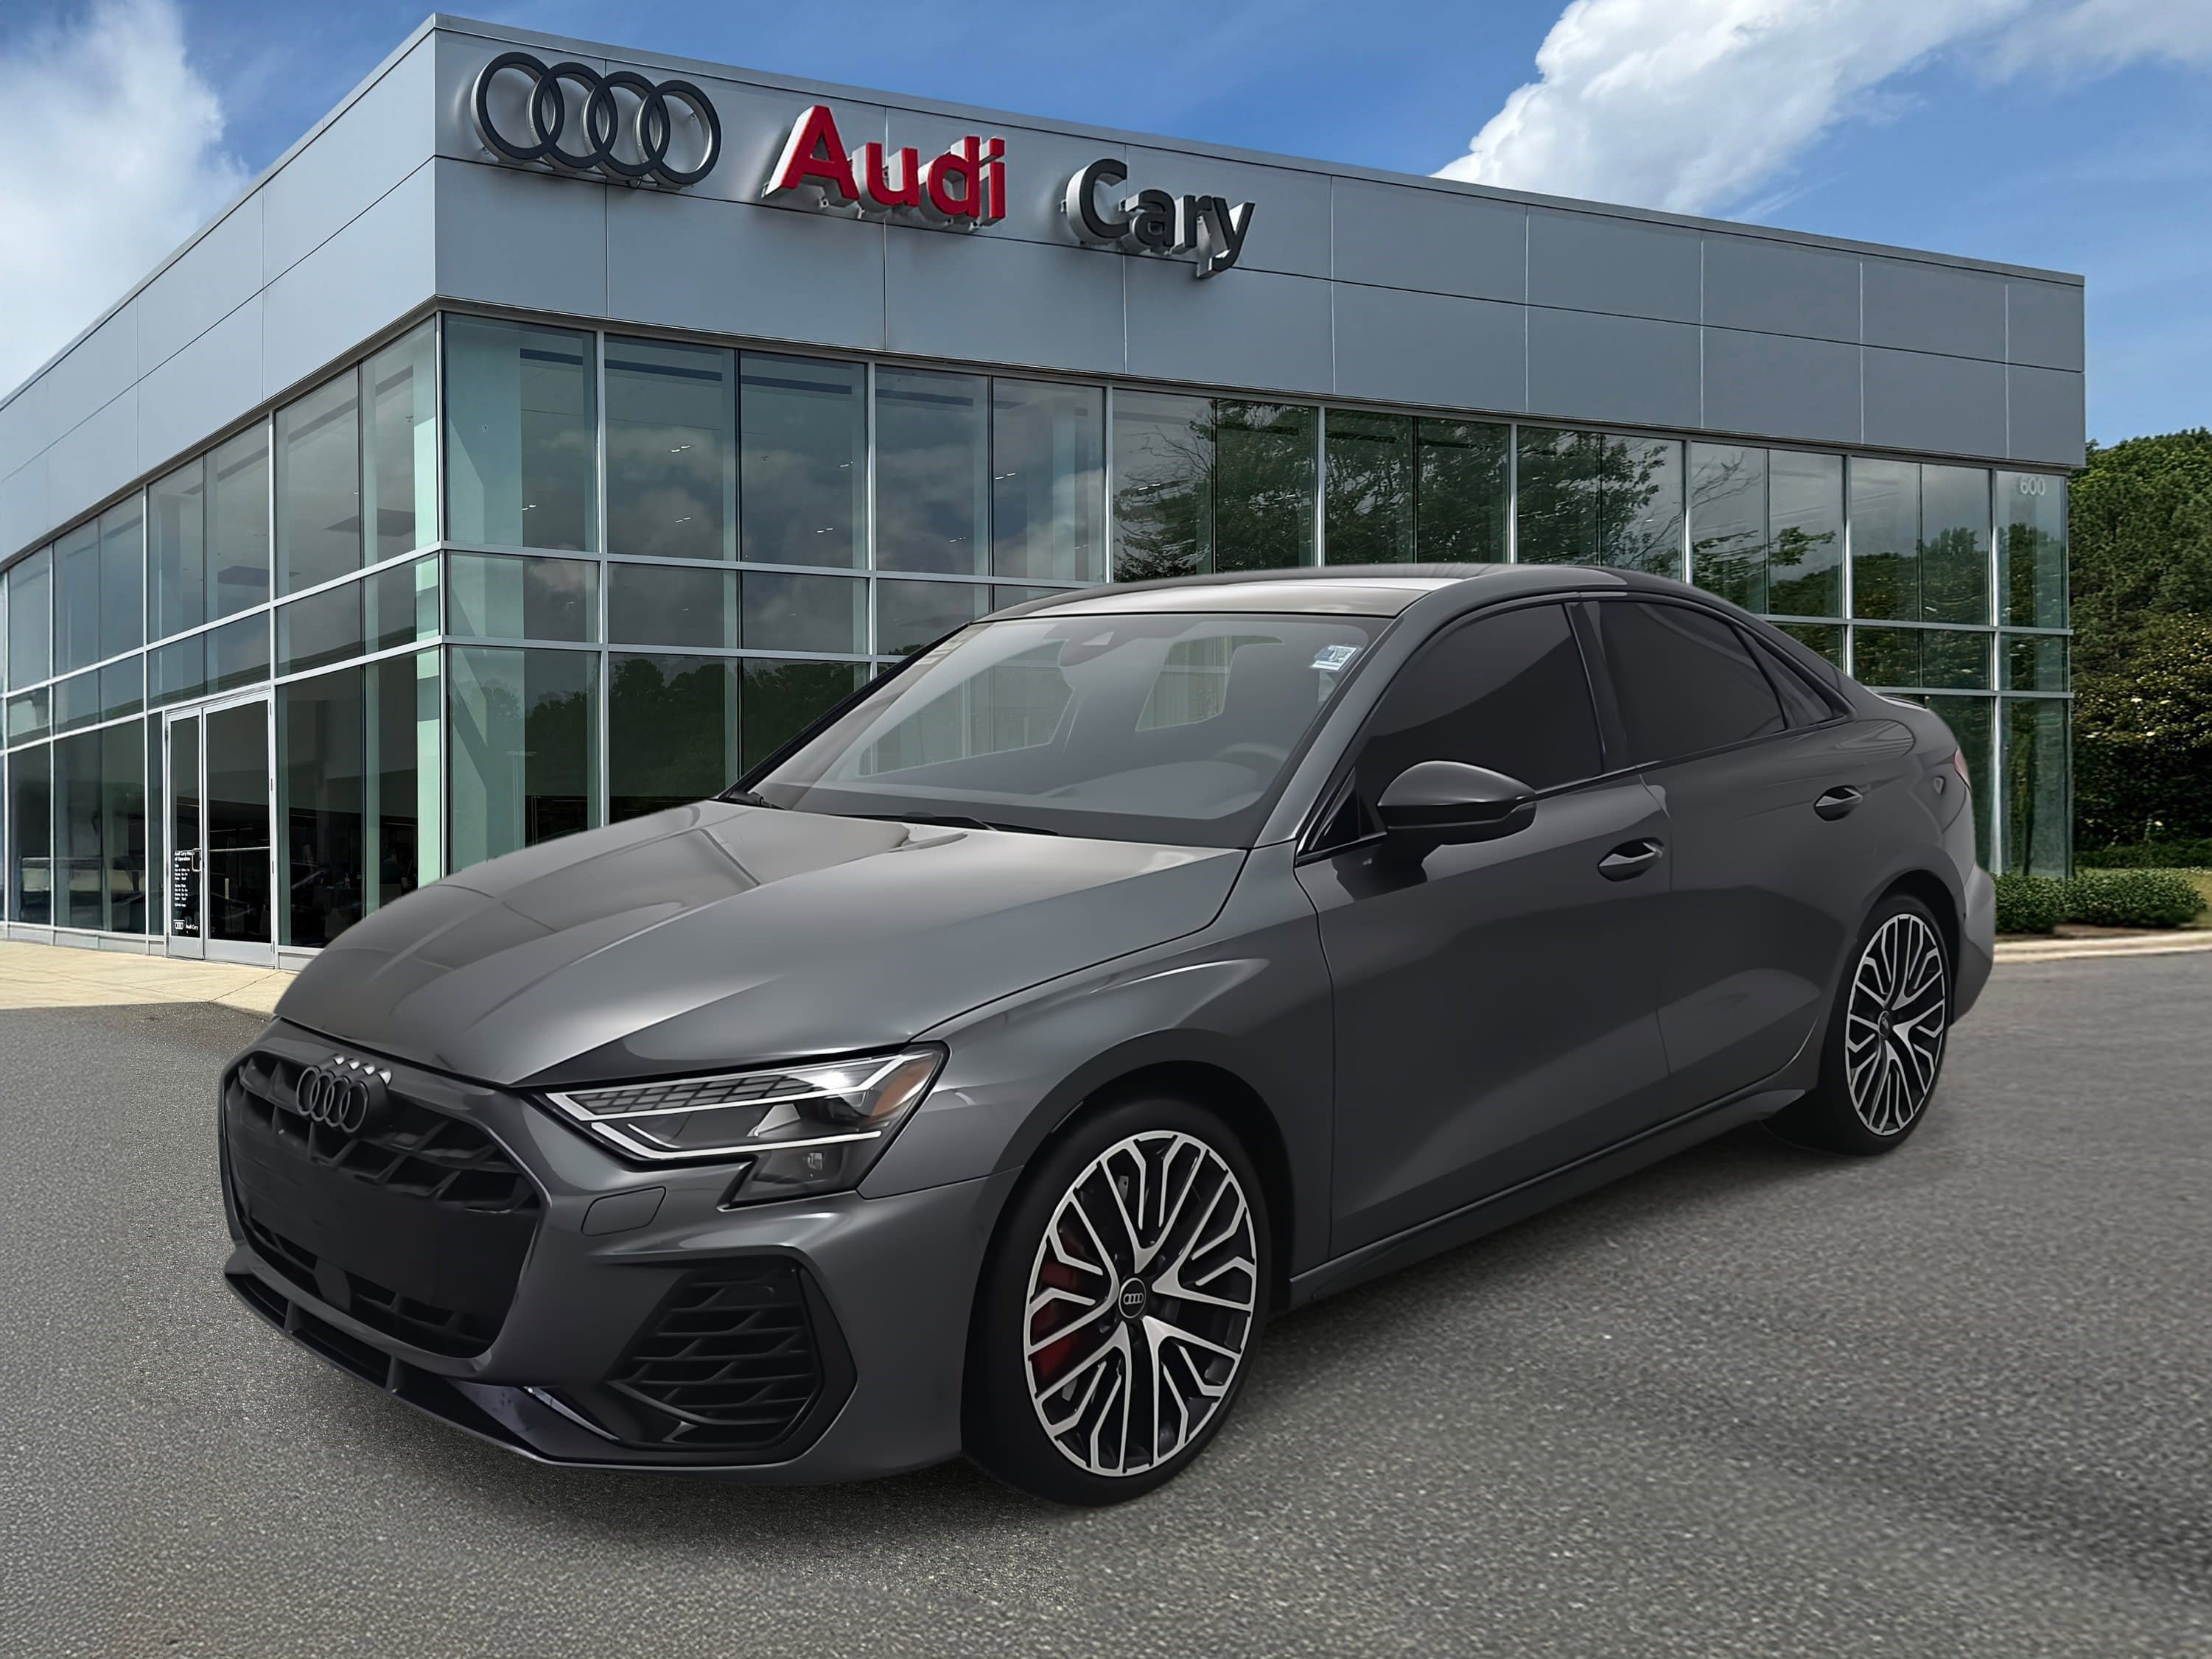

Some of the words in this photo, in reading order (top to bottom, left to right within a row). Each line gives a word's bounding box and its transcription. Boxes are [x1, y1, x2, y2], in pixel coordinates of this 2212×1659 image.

[770, 105, 1004, 225] Audi
[1073, 158, 1255, 274] Cary
[2020, 476, 2045, 495] 600
